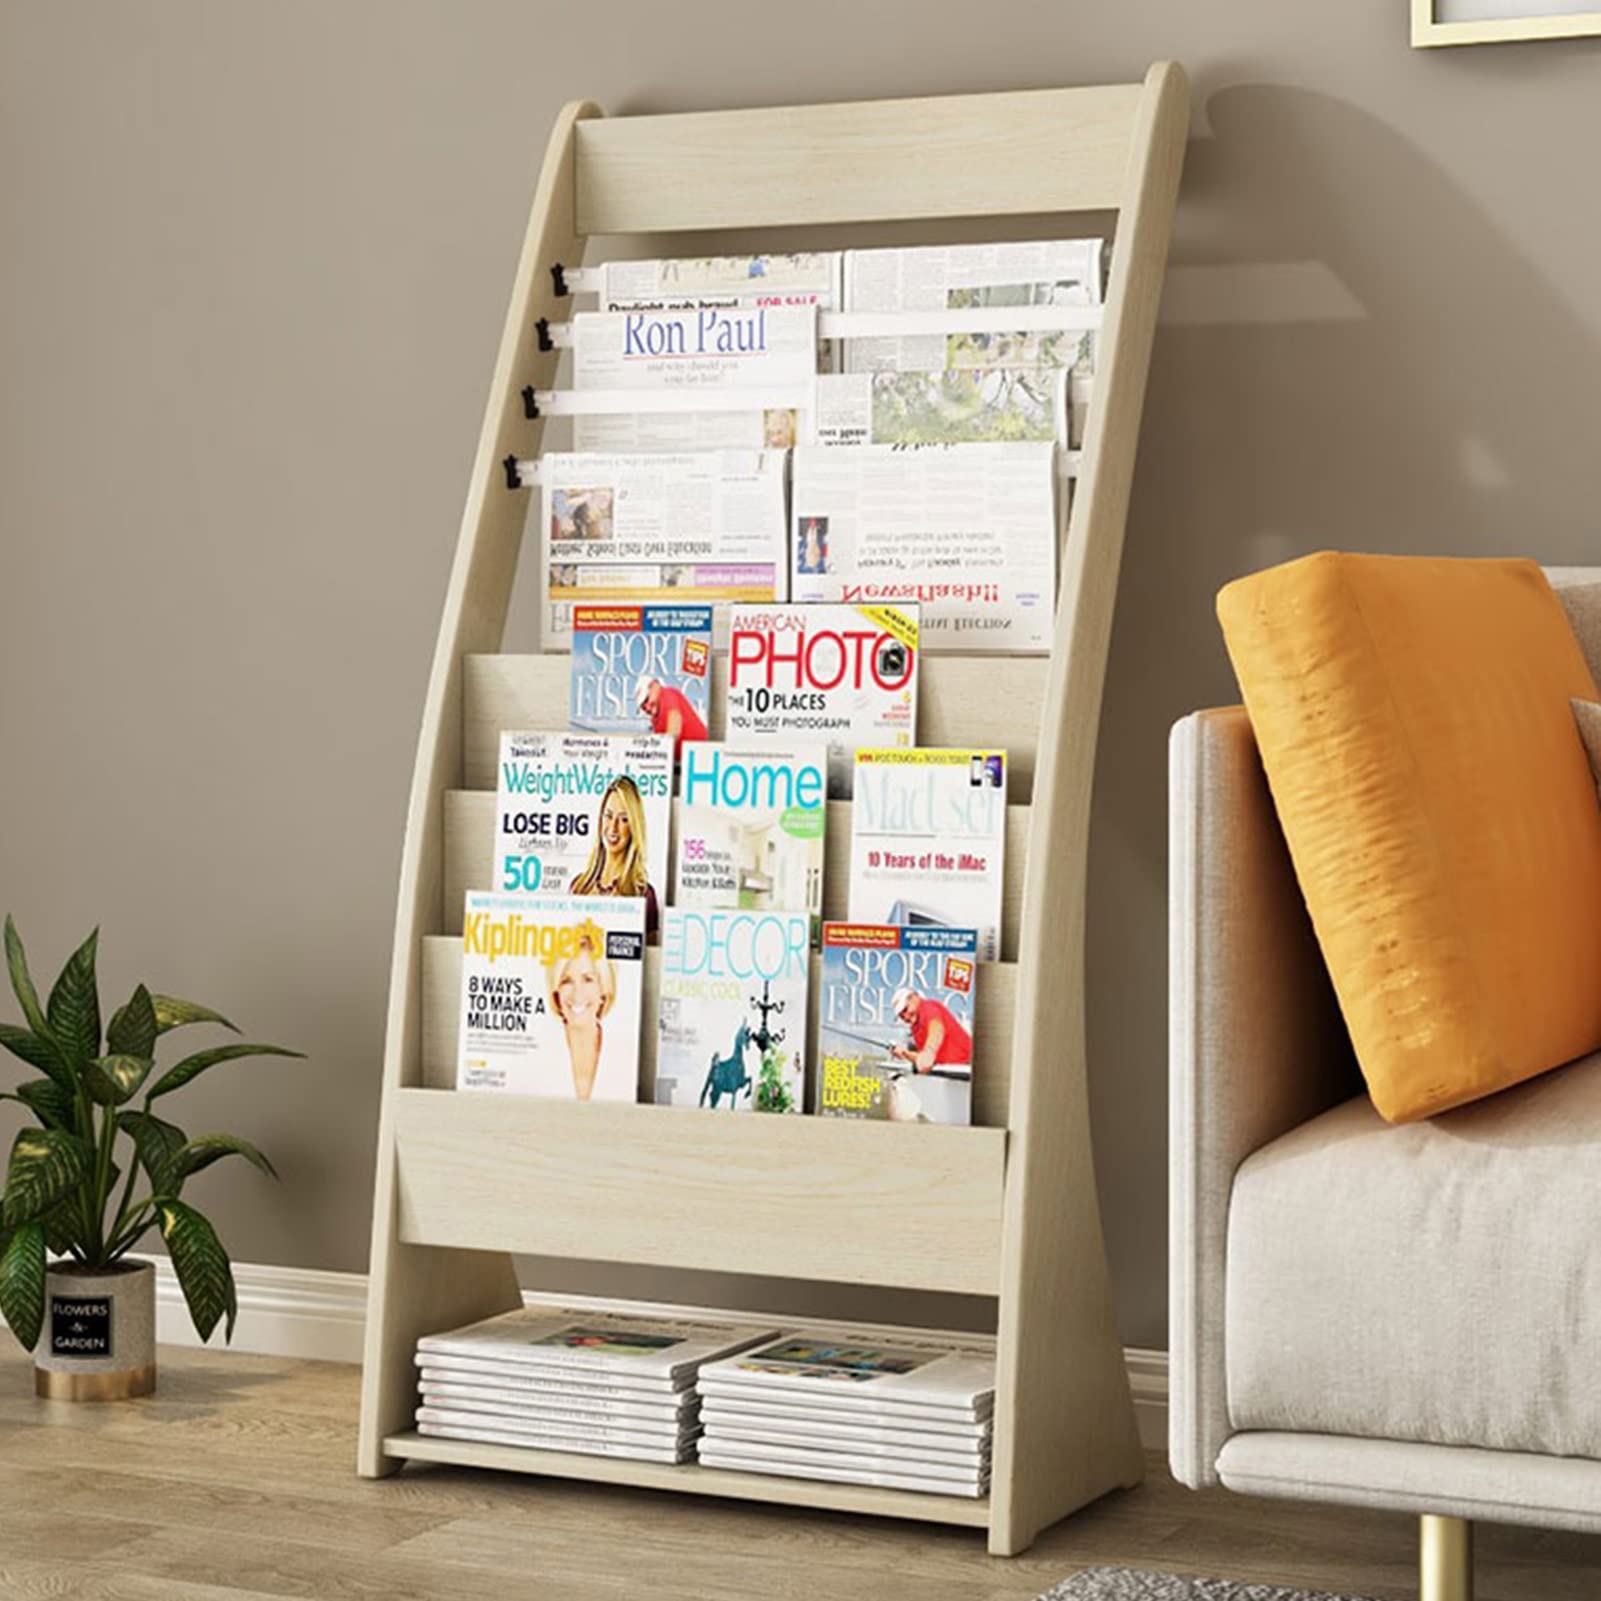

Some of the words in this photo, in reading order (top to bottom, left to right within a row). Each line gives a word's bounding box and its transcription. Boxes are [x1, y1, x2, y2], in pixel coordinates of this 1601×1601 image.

[624, 314, 686, 355] Ron
[696, 310, 767, 353] Paul
[733, 613, 807, 631] AMERICAN
[592, 631, 686, 676] SPORT
[729, 630, 914, 691] PHOTO
[576, 674, 706, 720] FISHG
[746, 688, 770, 713] 10
[773, 694, 827, 711] PLACES
[731, 716, 751, 728] YOU
[754, 716, 779, 728] MUST
[782, 717, 851, 730] PHOTOGRAPH
[503, 762, 669, 803] WeightWaters
[686, 750, 823, 809] Home
[503, 812, 551, 834] LOSE
[555, 814, 590, 836] BIG
[503, 855, 541, 891] 50
[868, 852, 881, 867] 10
[884, 852, 916, 869] Years
[918, 853, 931, 869] of
[934, 853, 955, 870] the
[957, 854, 986, 871] iMac
[681, 913, 808, 980] DECOR
[845, 948, 947, 990] SPORT
[469, 976, 479, 993] 8
[481, 977, 523, 995] WAYS
[468, 995, 487, 1011] TO
[490, 996, 532, 1014] MAKE
[535, 998, 545, 1014] A
[828, 985, 971, 1026] FISHG
[467, 1013, 528, 1032] MILLION
[53, 1302, 109, 1316] FLOWERS
[54, 1336, 106, 1349] GARDEN
